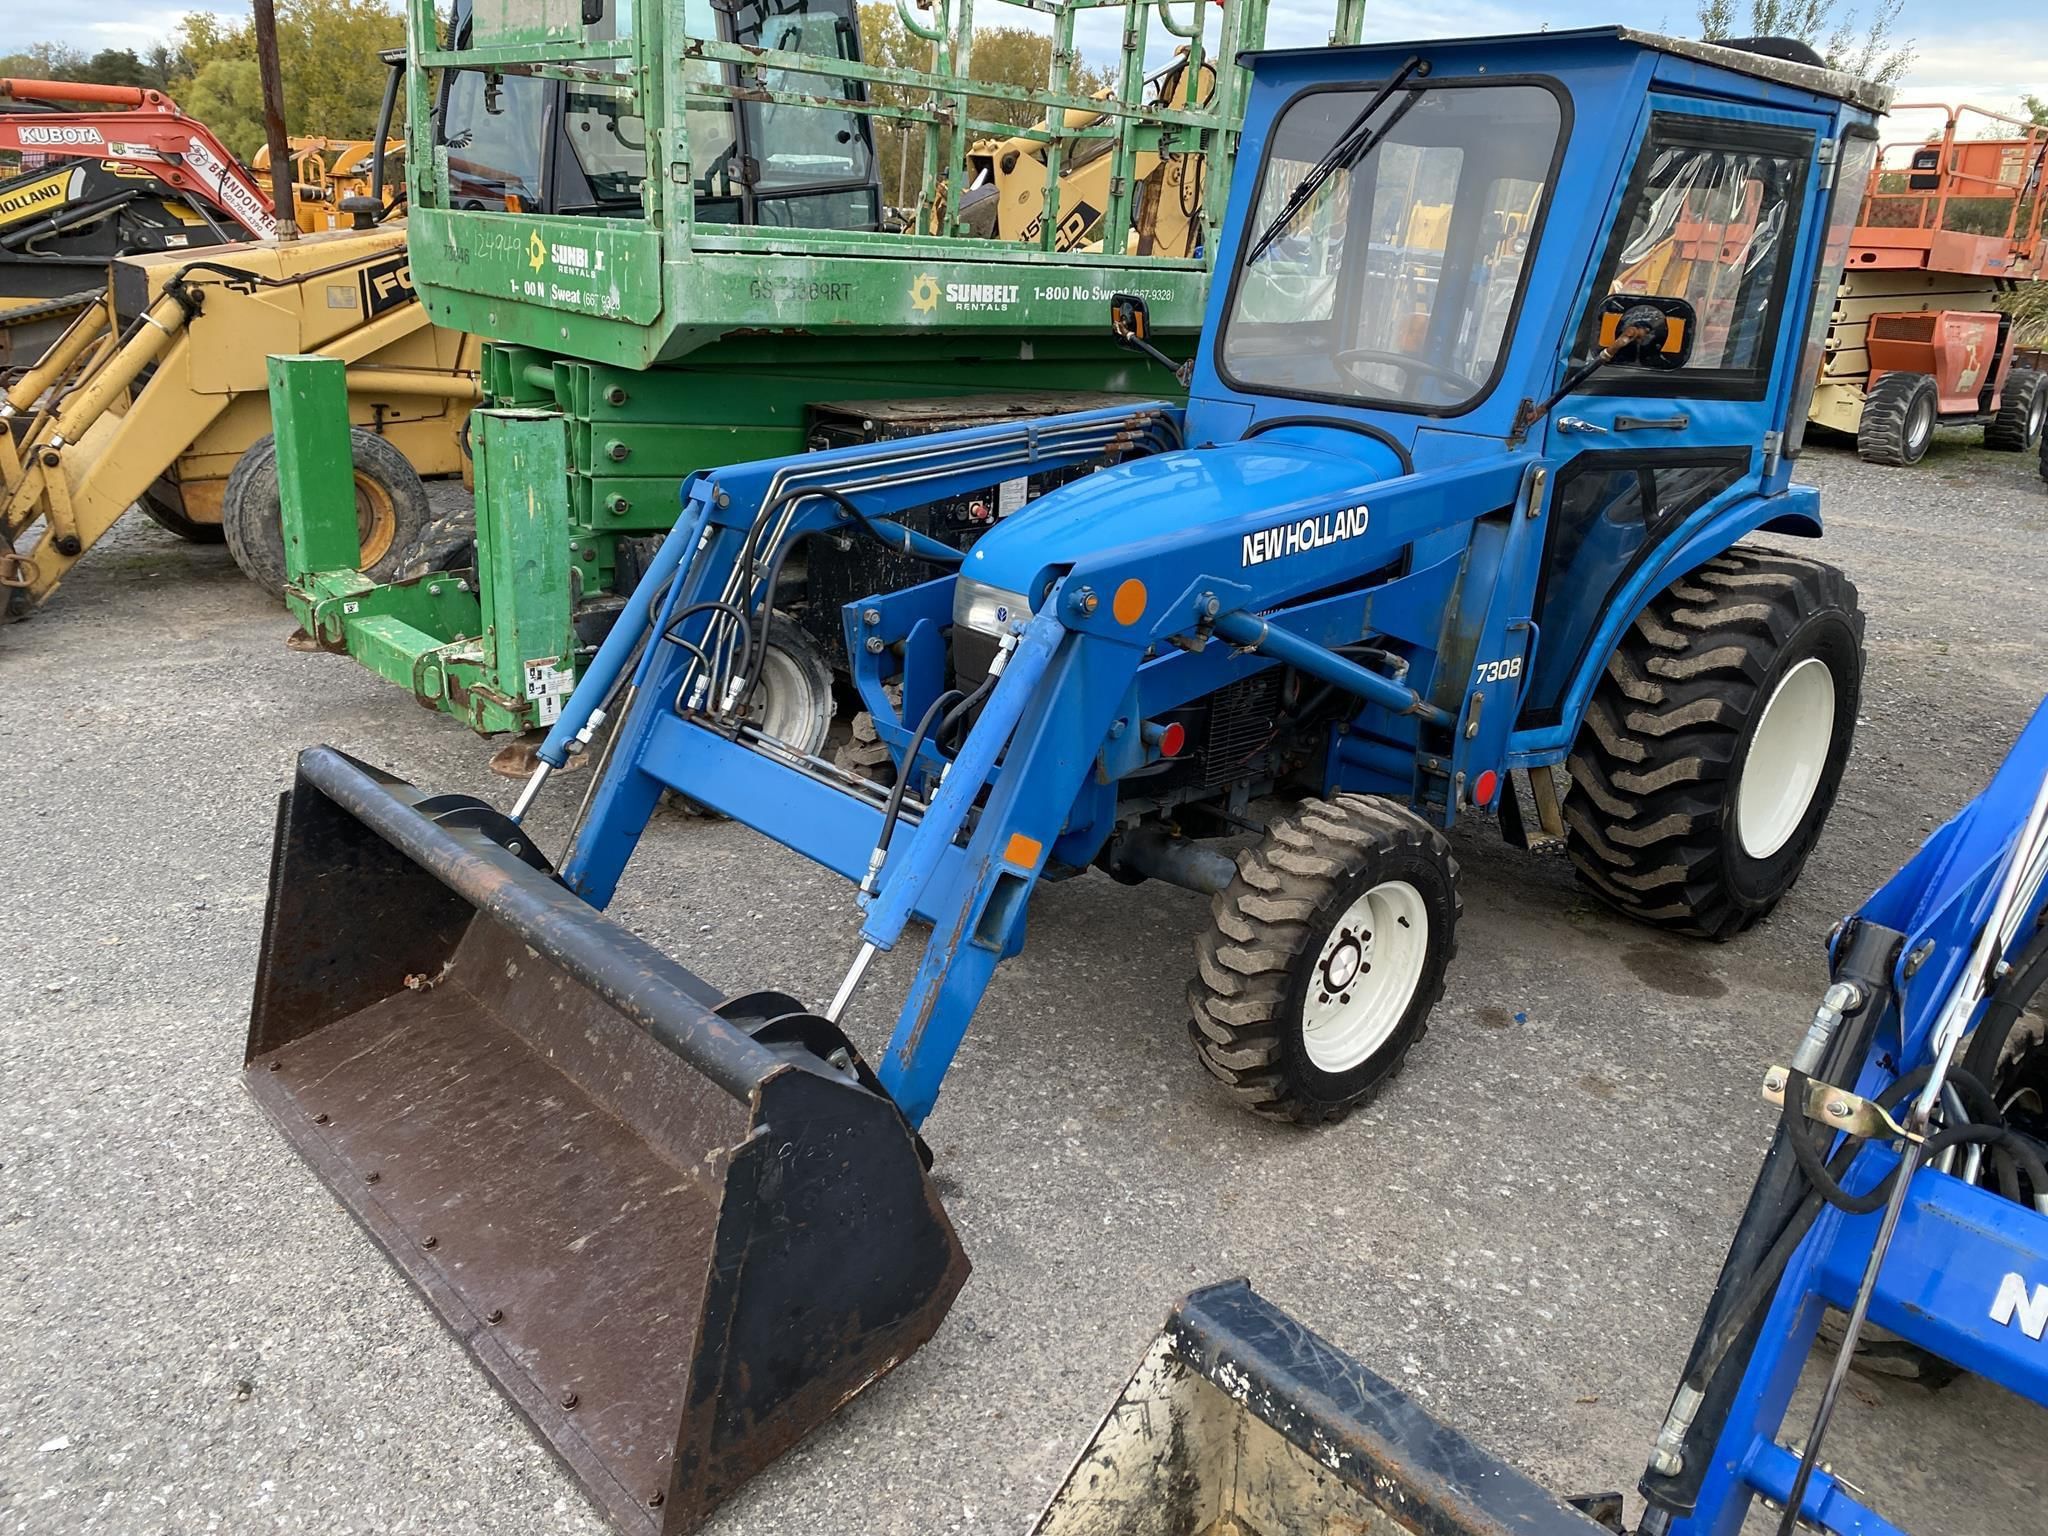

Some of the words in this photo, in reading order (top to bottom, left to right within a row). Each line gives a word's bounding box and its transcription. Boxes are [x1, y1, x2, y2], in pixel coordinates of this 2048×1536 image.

[18, 127, 104, 144] KUBOTA
[208, 162, 260, 214] BRANDON
[258, 213, 279, 236] REN
[551, 243, 607, 271] SUNBT
[558, 265, 596, 279] RENTALS
[510, 279, 535, 297] 1-00
[551, 286, 581, 304] Sweat
[945, 283, 1018, 303] SUNBELT
[1033, 286, 1069, 300] 1-800
[1072, 286, 1090, 300] No
[955, 303, 1008, 312] RENTALS
[1241, 526, 1285, 567] NEW
[1285, 505, 1370, 555] HOLLAND
[1476, 657, 1521, 684] 7308
